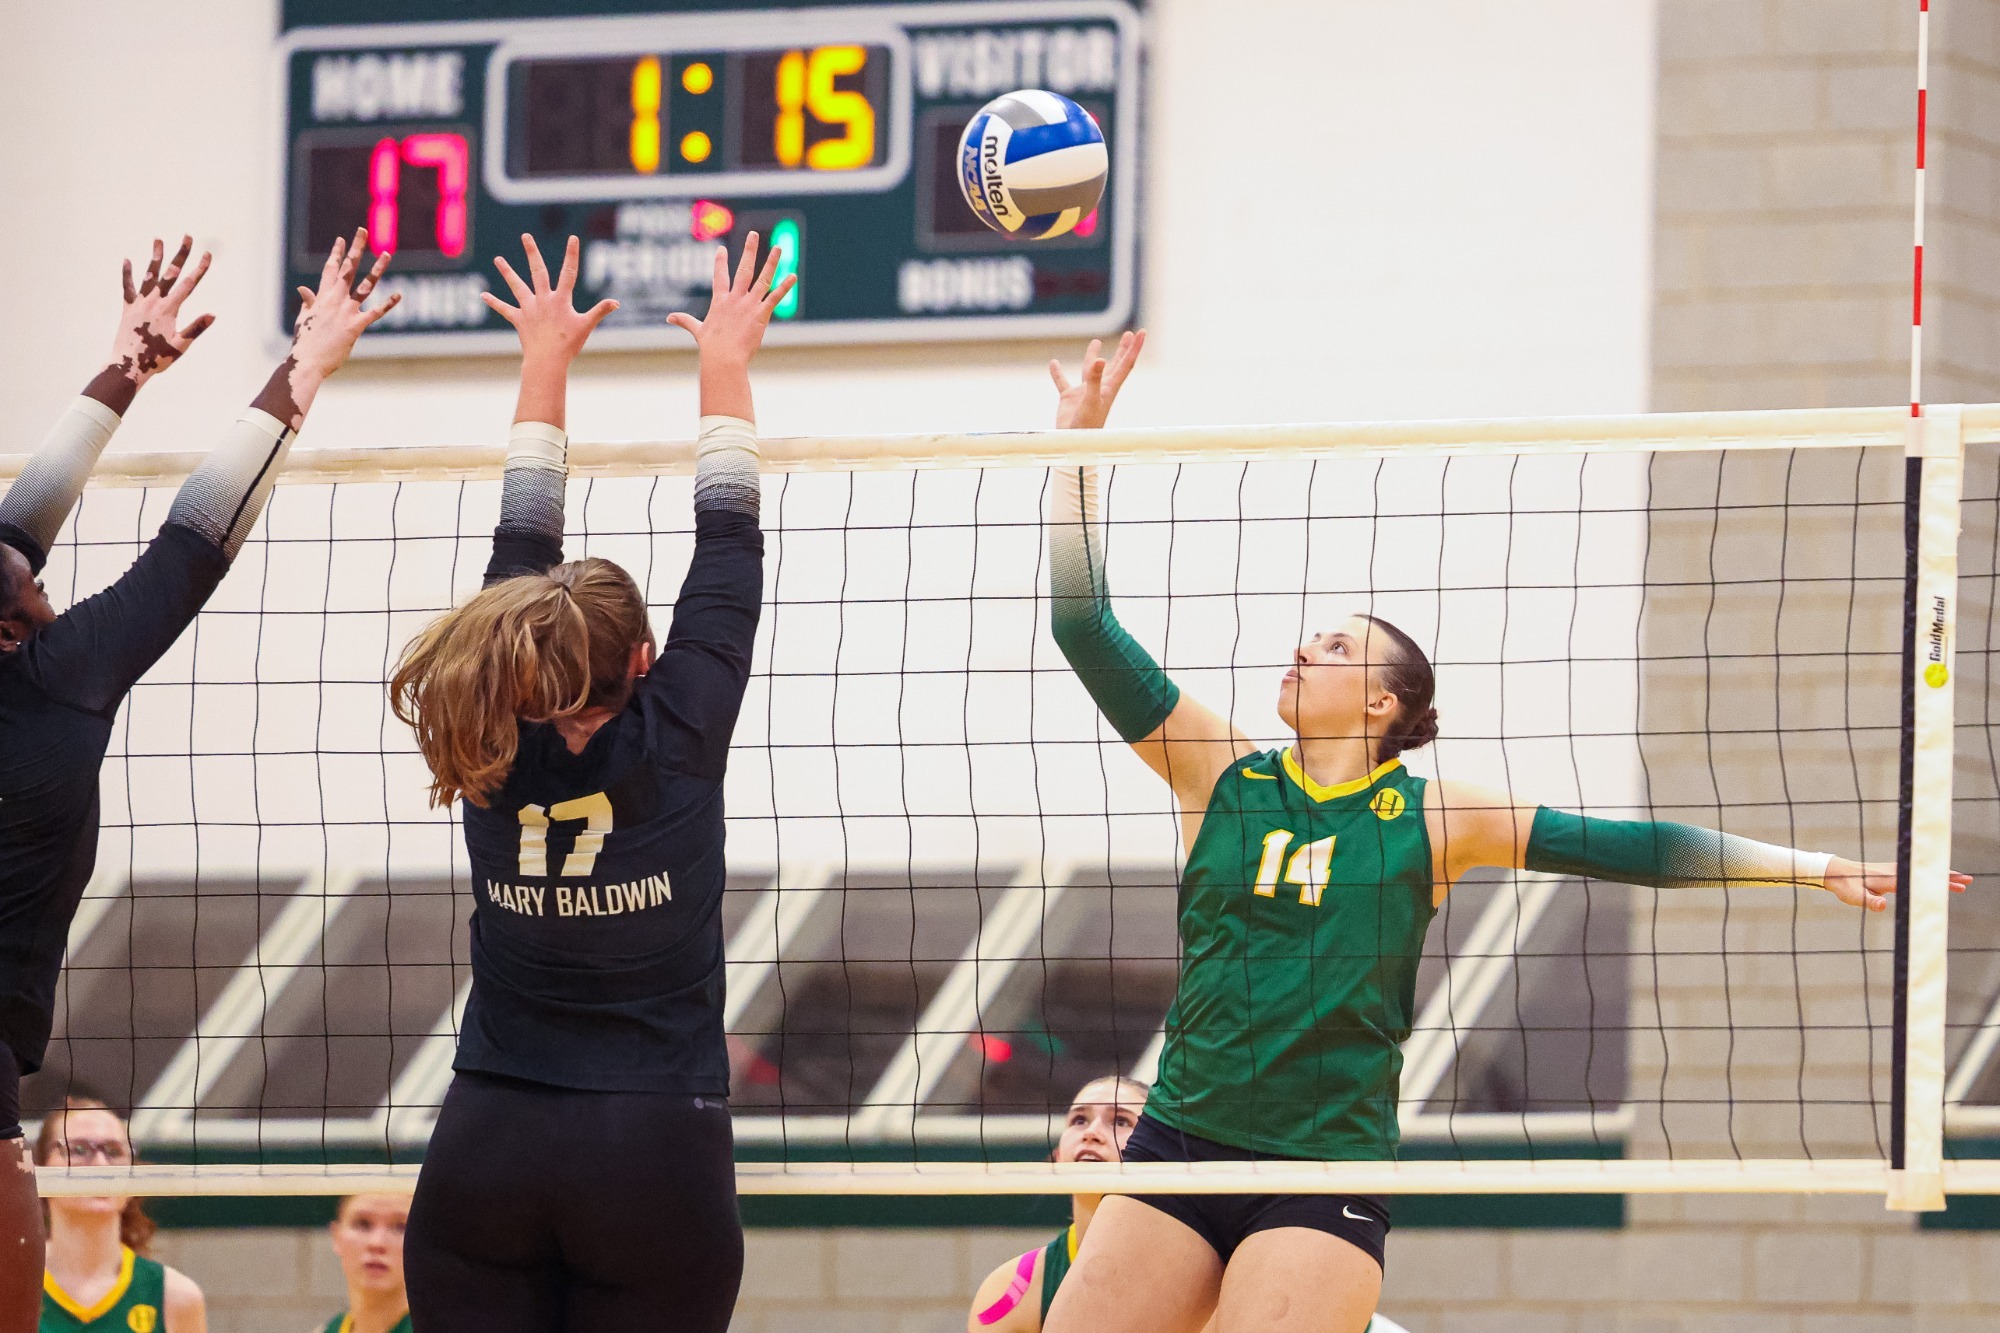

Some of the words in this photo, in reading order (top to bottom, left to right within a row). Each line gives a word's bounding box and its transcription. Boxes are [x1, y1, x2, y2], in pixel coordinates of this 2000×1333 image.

[312, 53, 465, 119] HOME
[368, 133, 468, 258] 17
[984, 135, 1009, 217] molten
[900, 256, 1034, 312] BONUS
[517, 791, 613, 877] 17
[1253, 828, 1337, 907] 14
[555, 871, 672, 917] BALDWIN
